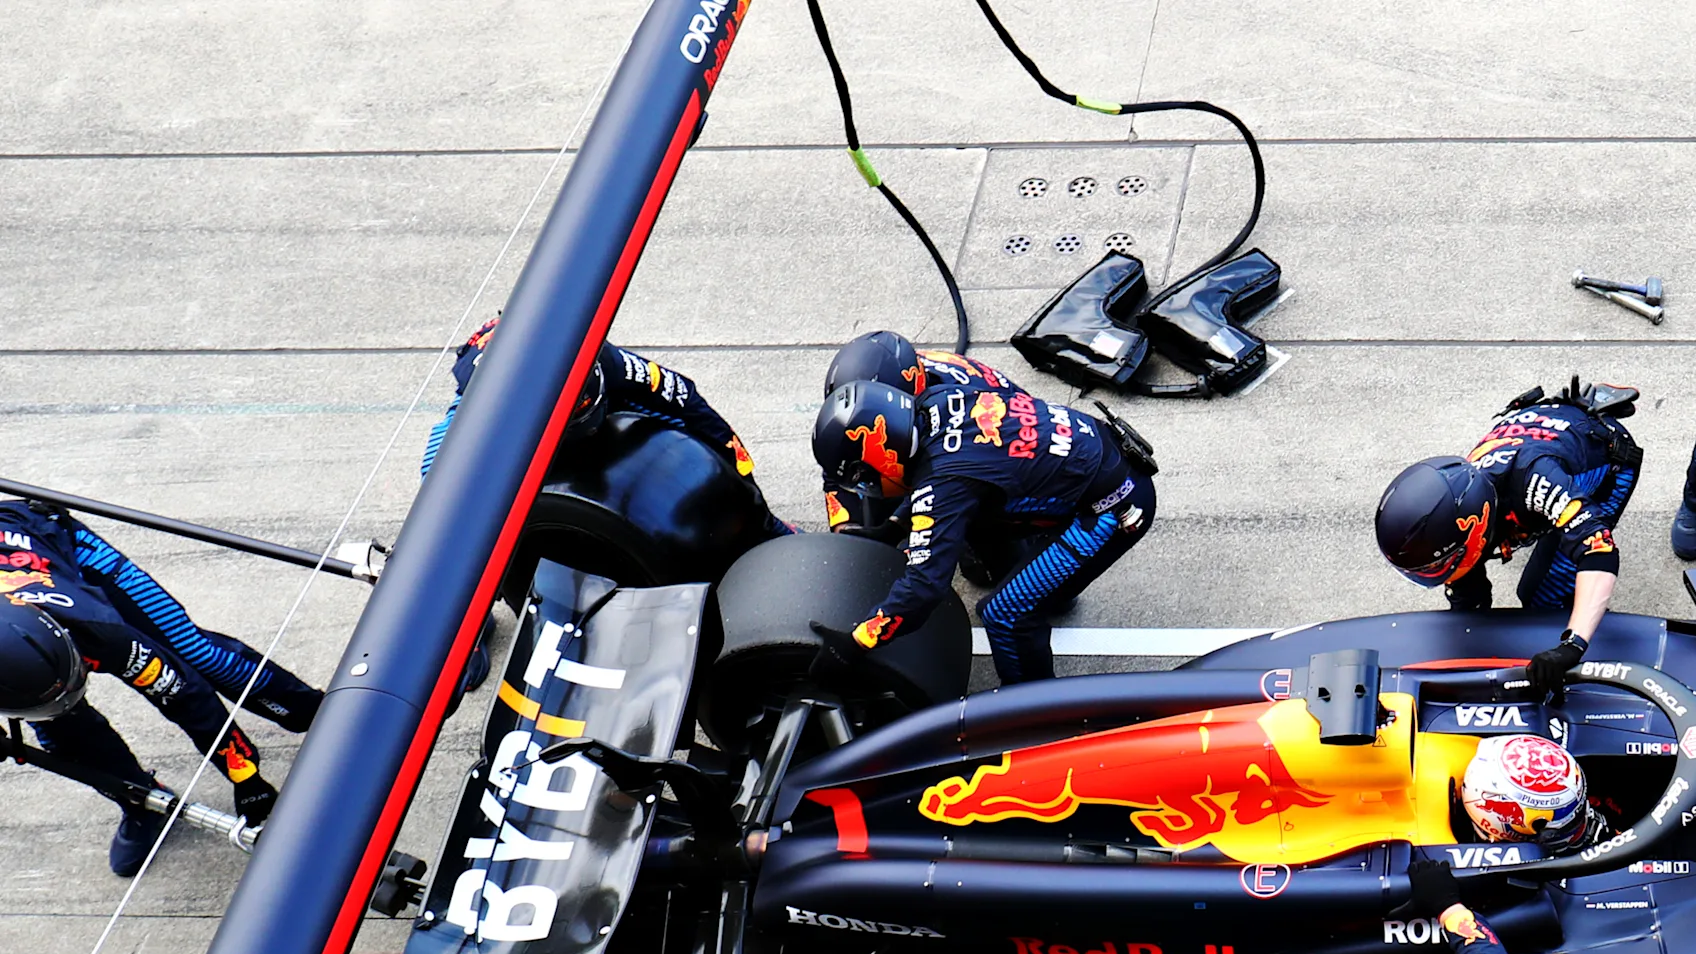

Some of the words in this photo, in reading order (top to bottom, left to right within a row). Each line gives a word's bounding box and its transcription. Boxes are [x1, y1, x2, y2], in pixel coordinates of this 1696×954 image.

[1090, 477, 1135, 513] sparco
[1581, 660, 1632, 681] BYBIT
[1642, 677, 1688, 718] ORACLE
[1455, 705, 1528, 728] VISA
[1642, 742, 1678, 756] Mobil
[446, 620, 627, 942] BYBIT
[1522, 794, 1548, 806] Player
[1651, 776, 1690, 826] telcel
[1447, 847, 1522, 869] VISA
[1628, 861, 1673, 874] Mobil
[786, 906, 945, 939] HONDA
